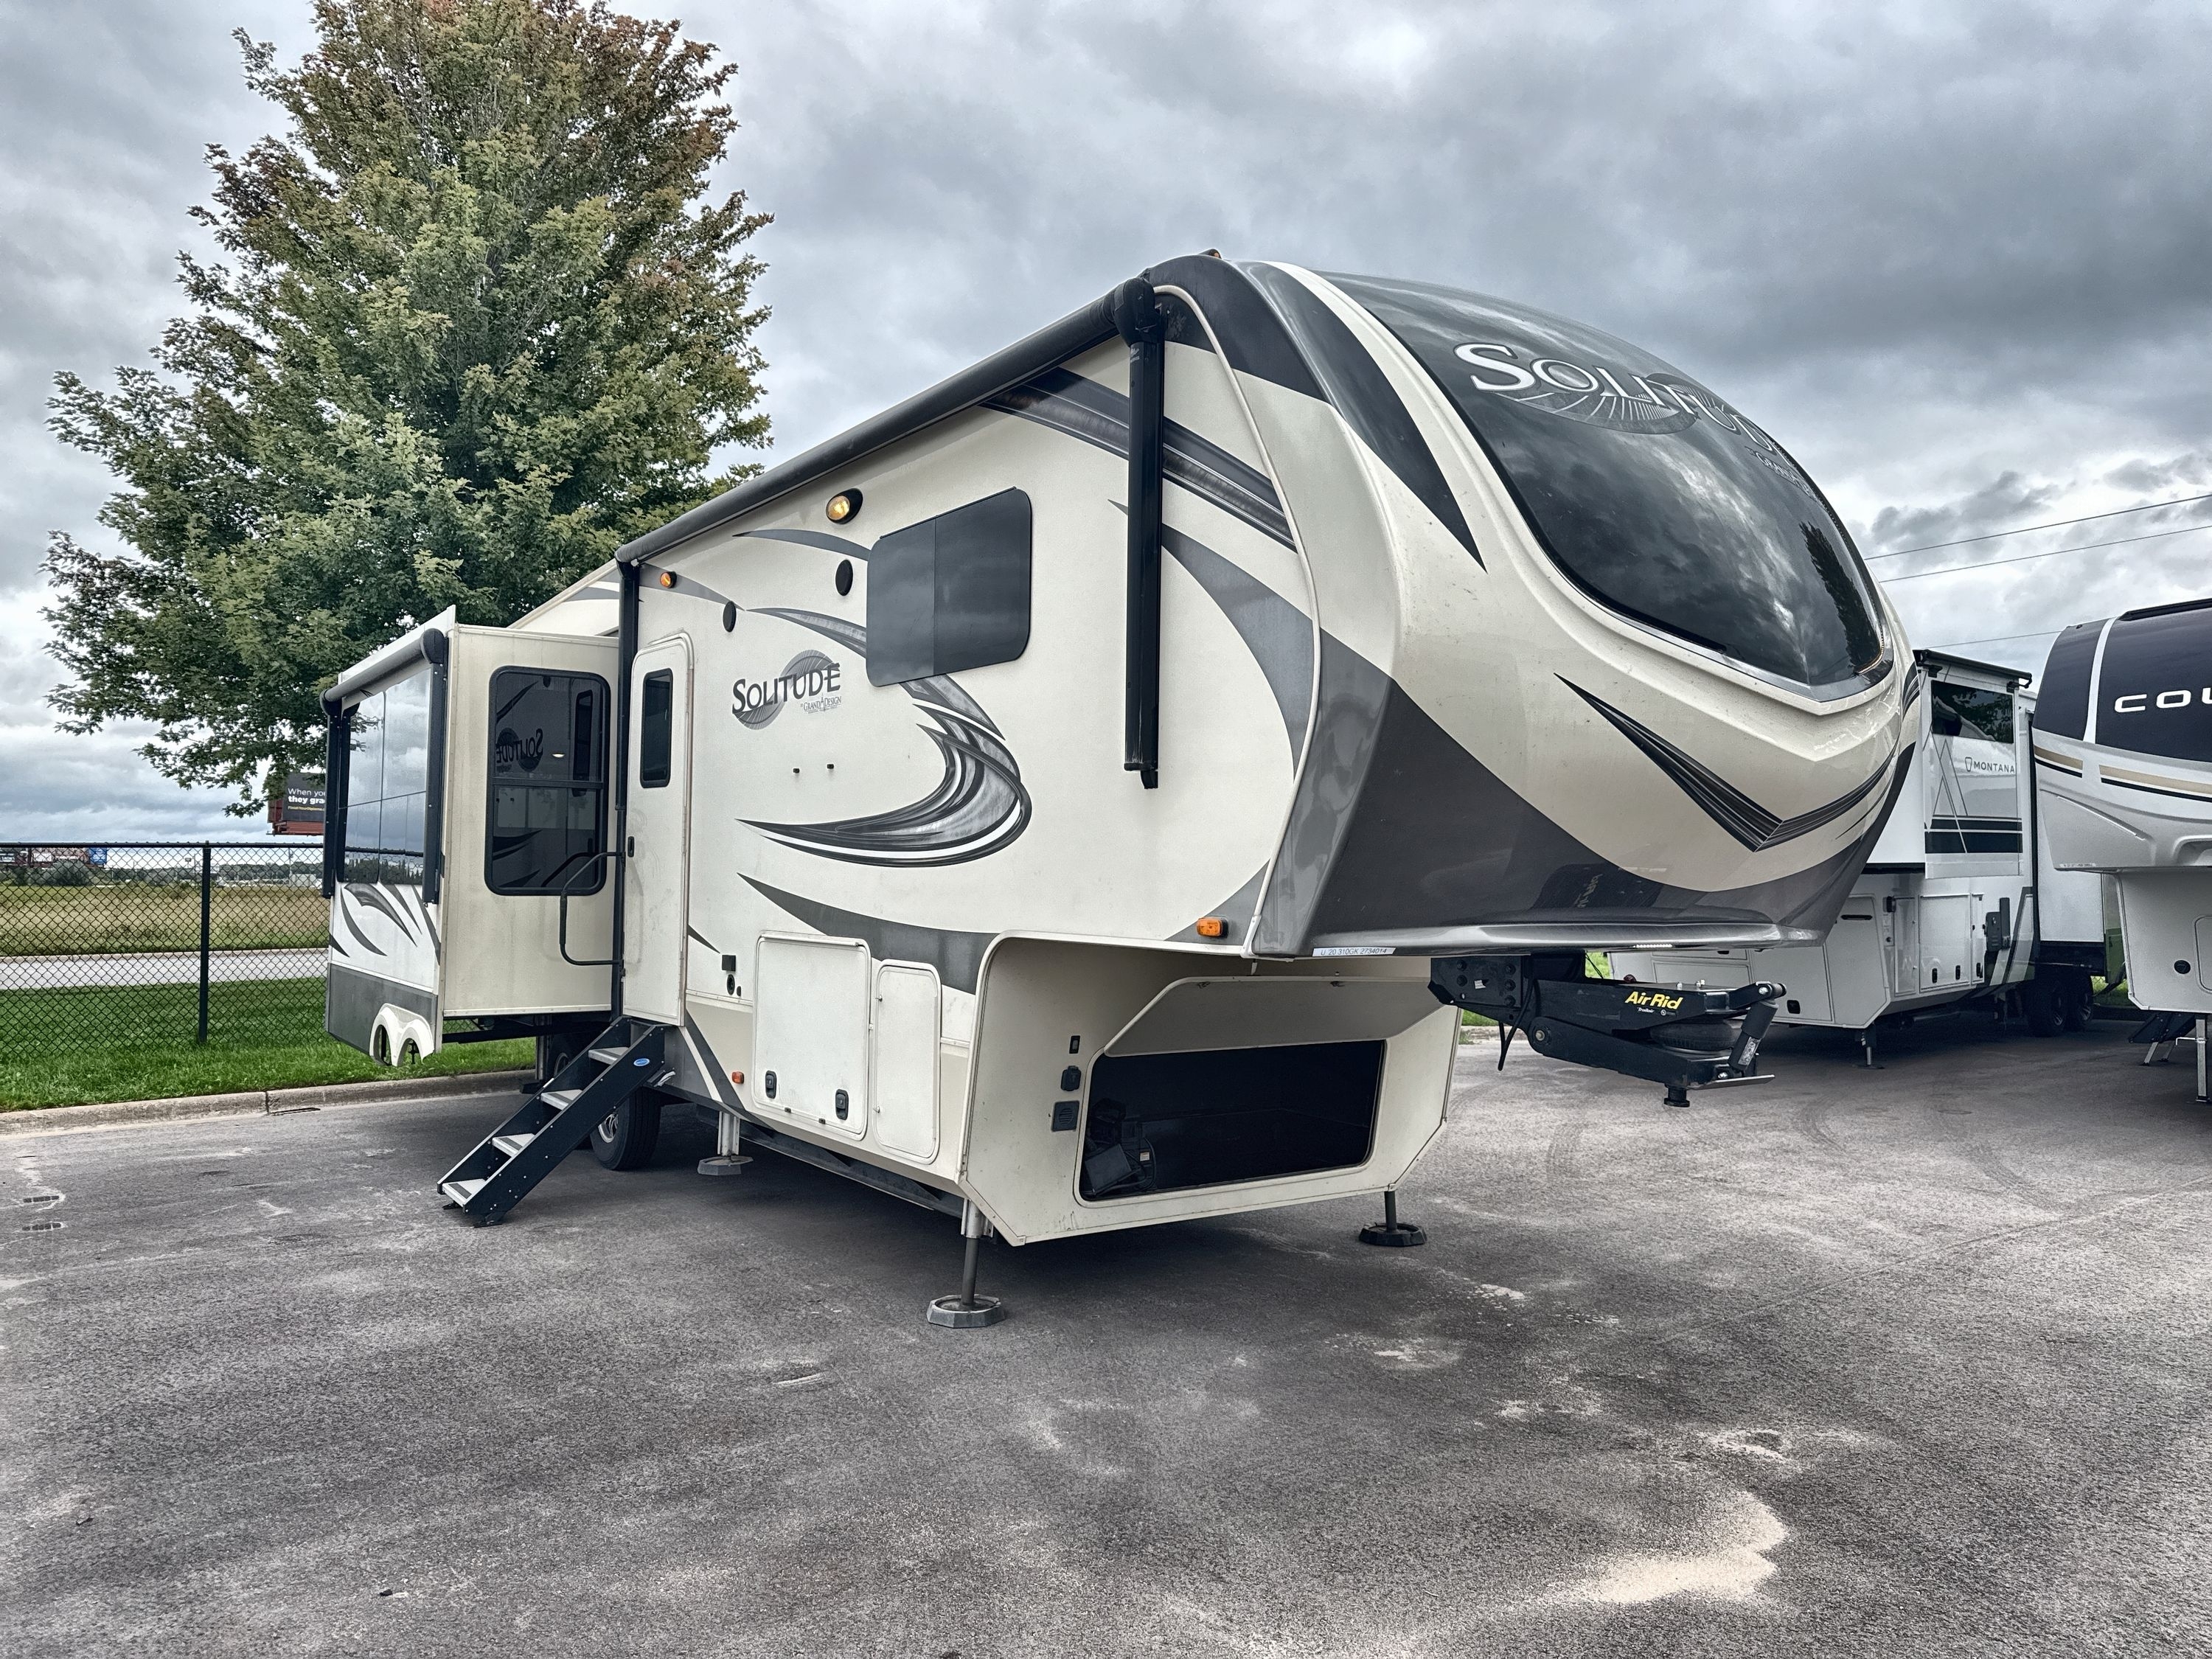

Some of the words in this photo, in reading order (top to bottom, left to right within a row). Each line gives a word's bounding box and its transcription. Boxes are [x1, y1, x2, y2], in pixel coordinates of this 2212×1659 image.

[1453, 342, 1793, 467] SOLITUD
[732, 663, 841, 714] SOLITUDE
[804, 700, 821, 712] GRAND
[824, 696, 842, 707] DESIGN
[1974, 761, 2015, 773] MONTANA
[288, 787, 312, 796] When
[288, 796, 308, 804] they
